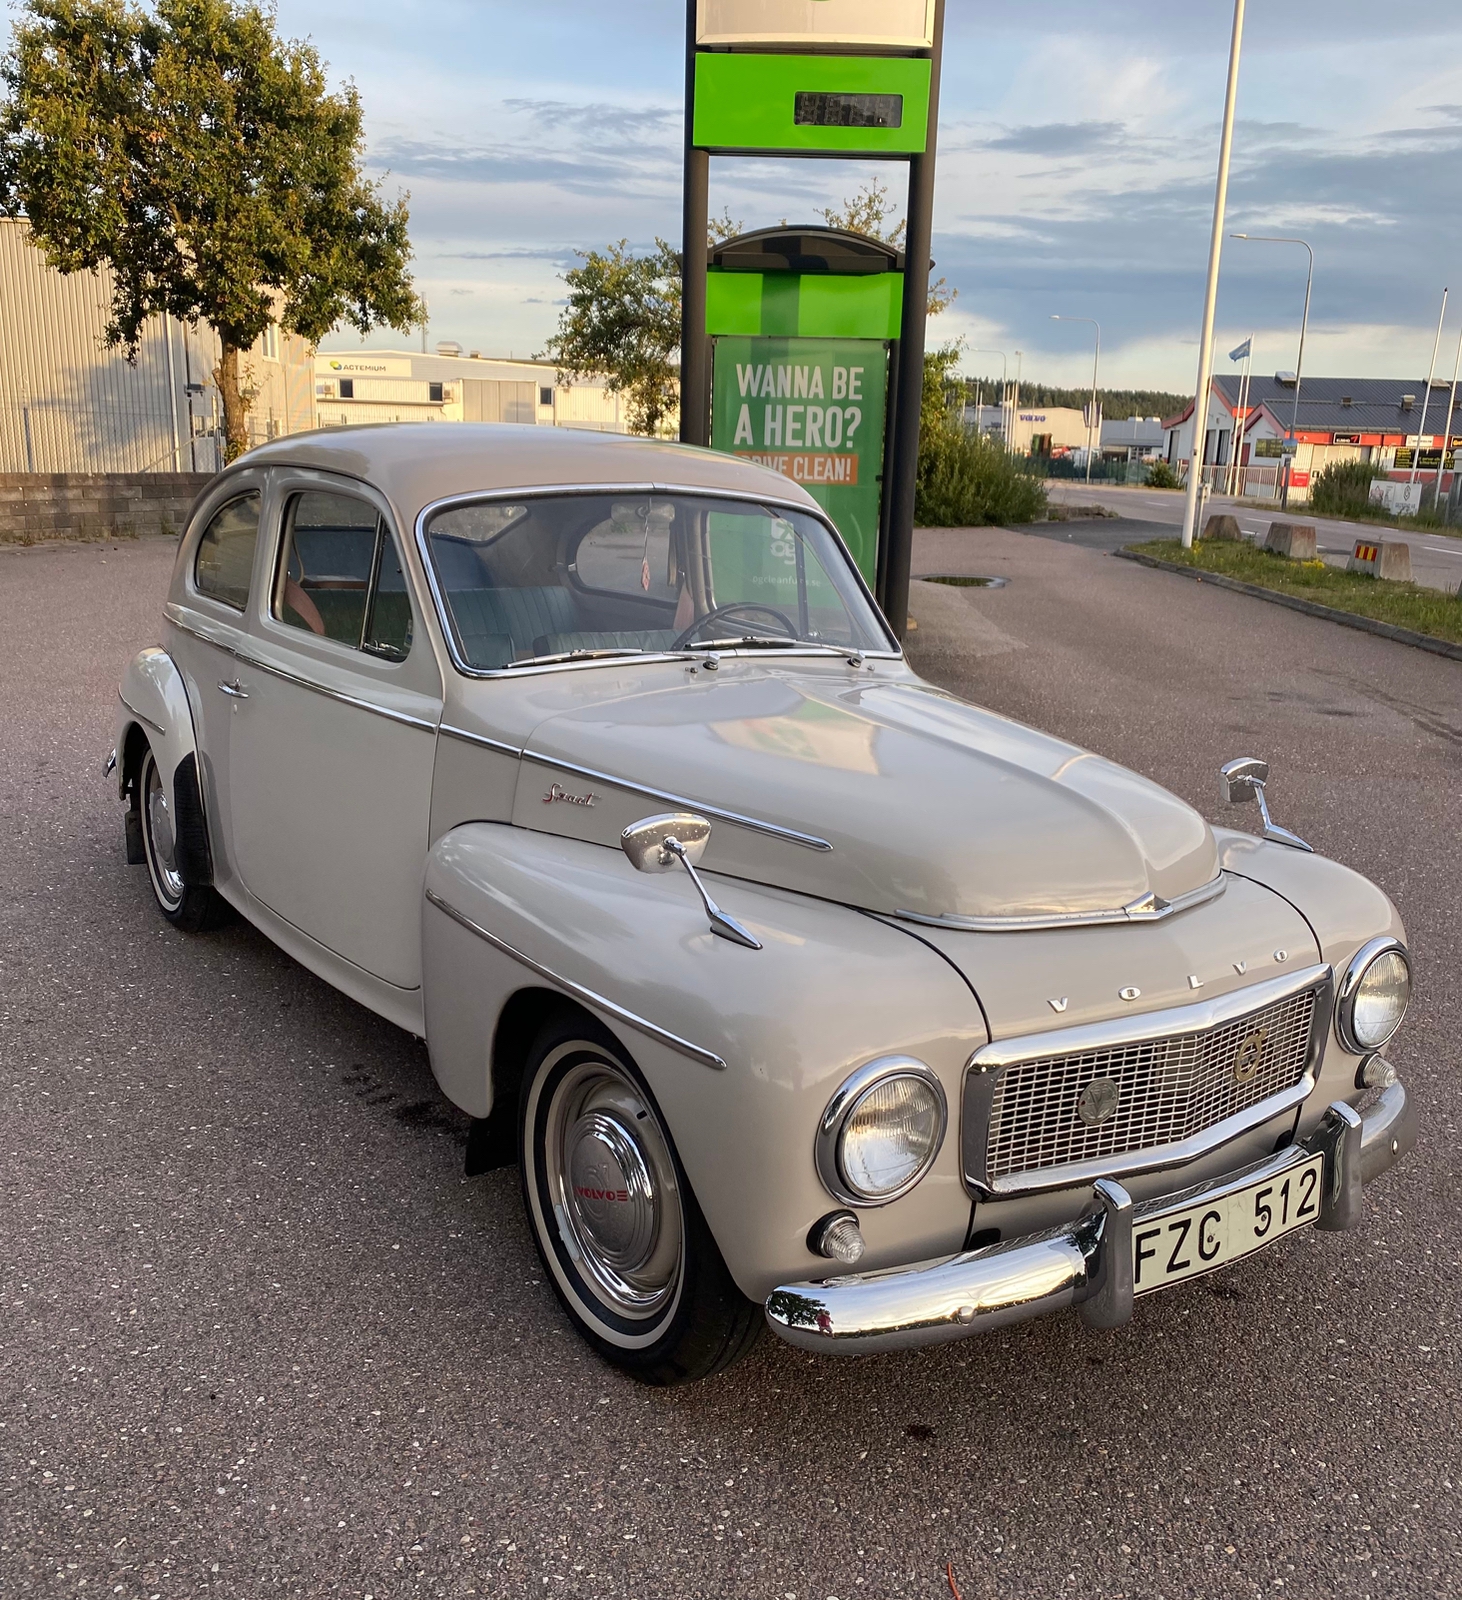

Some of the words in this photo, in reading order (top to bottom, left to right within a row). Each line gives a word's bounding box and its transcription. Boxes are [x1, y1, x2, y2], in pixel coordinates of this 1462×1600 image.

[343, 364, 387, 372] ACTEMIUM
[736, 363, 825, 399] WANNA
[832, 366, 864, 400] BE
[733, 403, 753, 445] A
[764, 404, 862, 448] HERO?
[1020, 414, 1046, 423] VOLVO
[793, 456, 851, 481] CLEAN!
[1047, 949, 1289, 1014] VOLVO
[574, 1186, 616, 1201] VOLVO
[1134, 1210, 1222, 1285] FZC
[1253, 1167, 1318, 1238] 512
